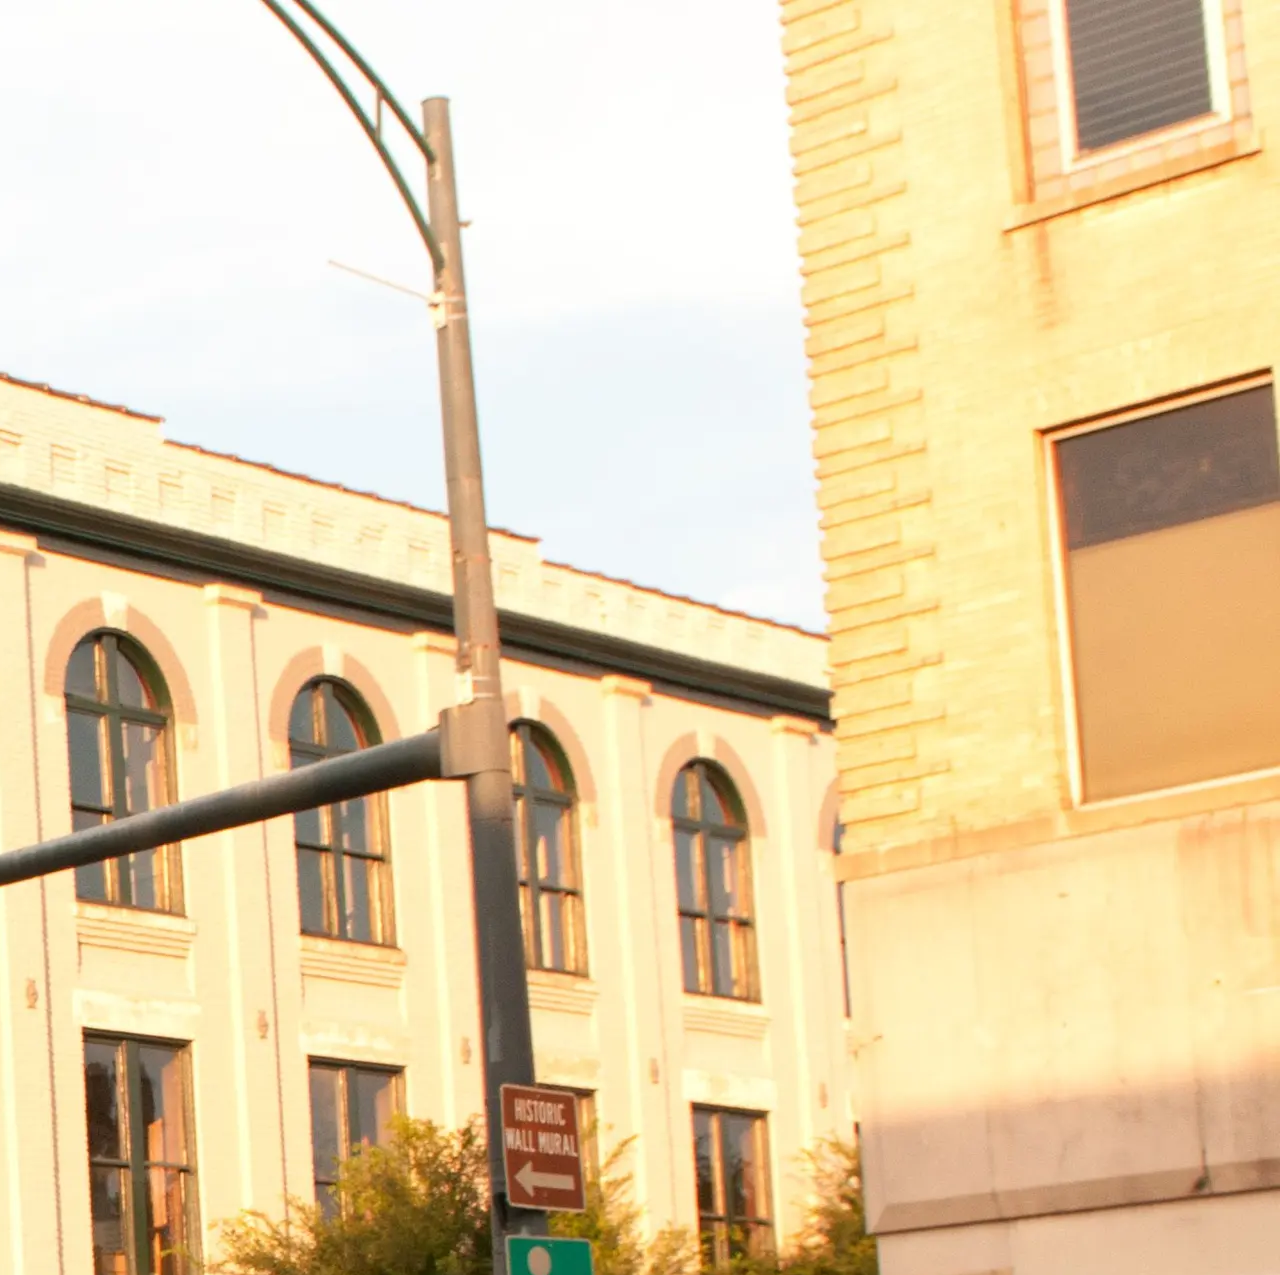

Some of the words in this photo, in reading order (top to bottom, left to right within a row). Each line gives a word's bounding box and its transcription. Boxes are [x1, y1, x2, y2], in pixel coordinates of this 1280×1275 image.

[514, 1098, 566, 1126] HISTORIC
[505, 1127, 536, 1153] WALL
[538, 1131, 578, 1157] MURAL
